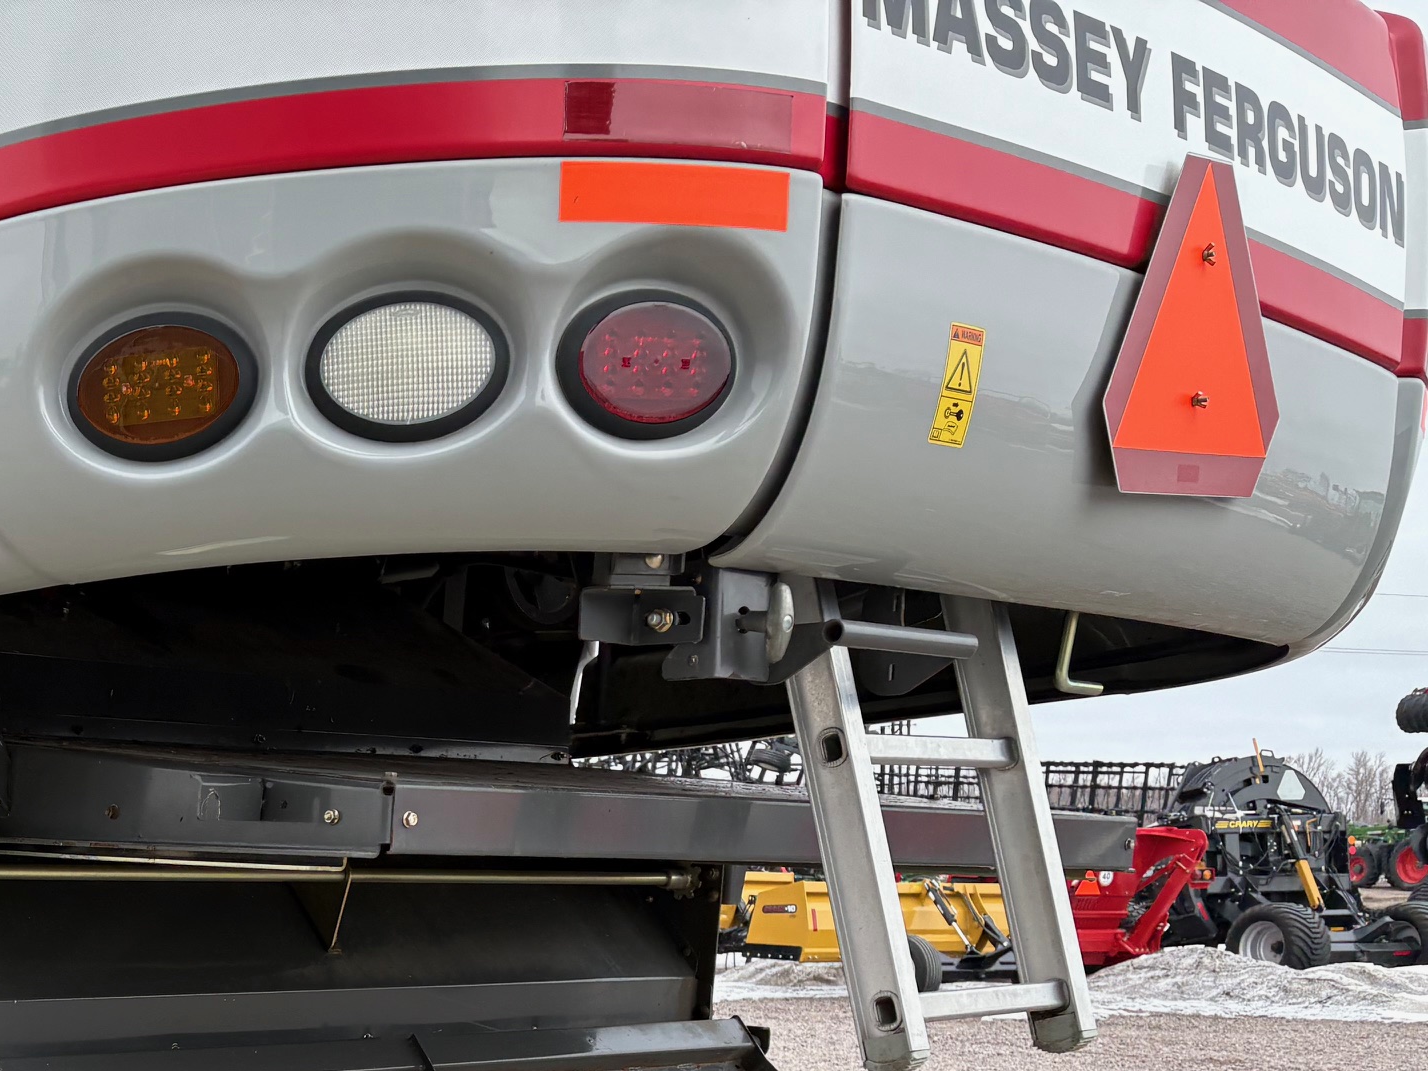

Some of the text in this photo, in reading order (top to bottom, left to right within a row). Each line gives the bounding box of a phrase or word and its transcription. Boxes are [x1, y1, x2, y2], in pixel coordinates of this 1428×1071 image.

[1171, 51, 1405, 248] FERGUSON
[1228, 820, 1258, 828] CRARY
[1102, 872, 1111, 880] 40
